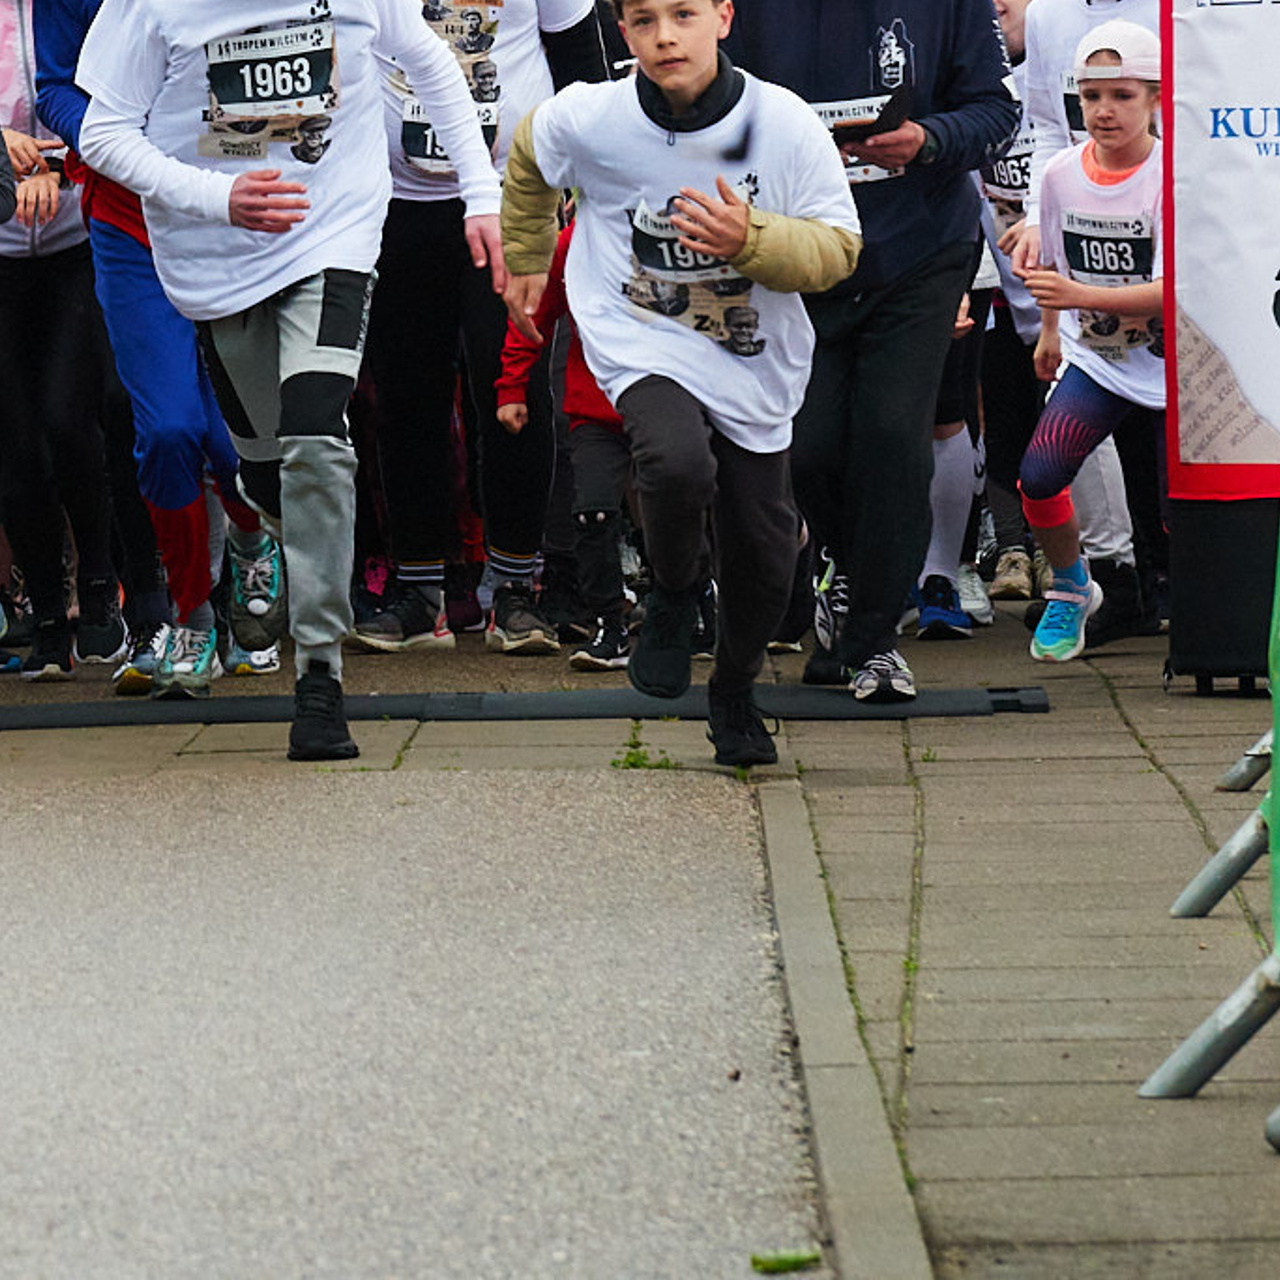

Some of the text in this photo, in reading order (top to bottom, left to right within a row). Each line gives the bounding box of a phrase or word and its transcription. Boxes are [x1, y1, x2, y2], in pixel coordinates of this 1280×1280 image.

[239, 57, 312, 98] 1963
[992, 157, 1031, 187] 1963
[1080, 239, 1135, 272] 1963
